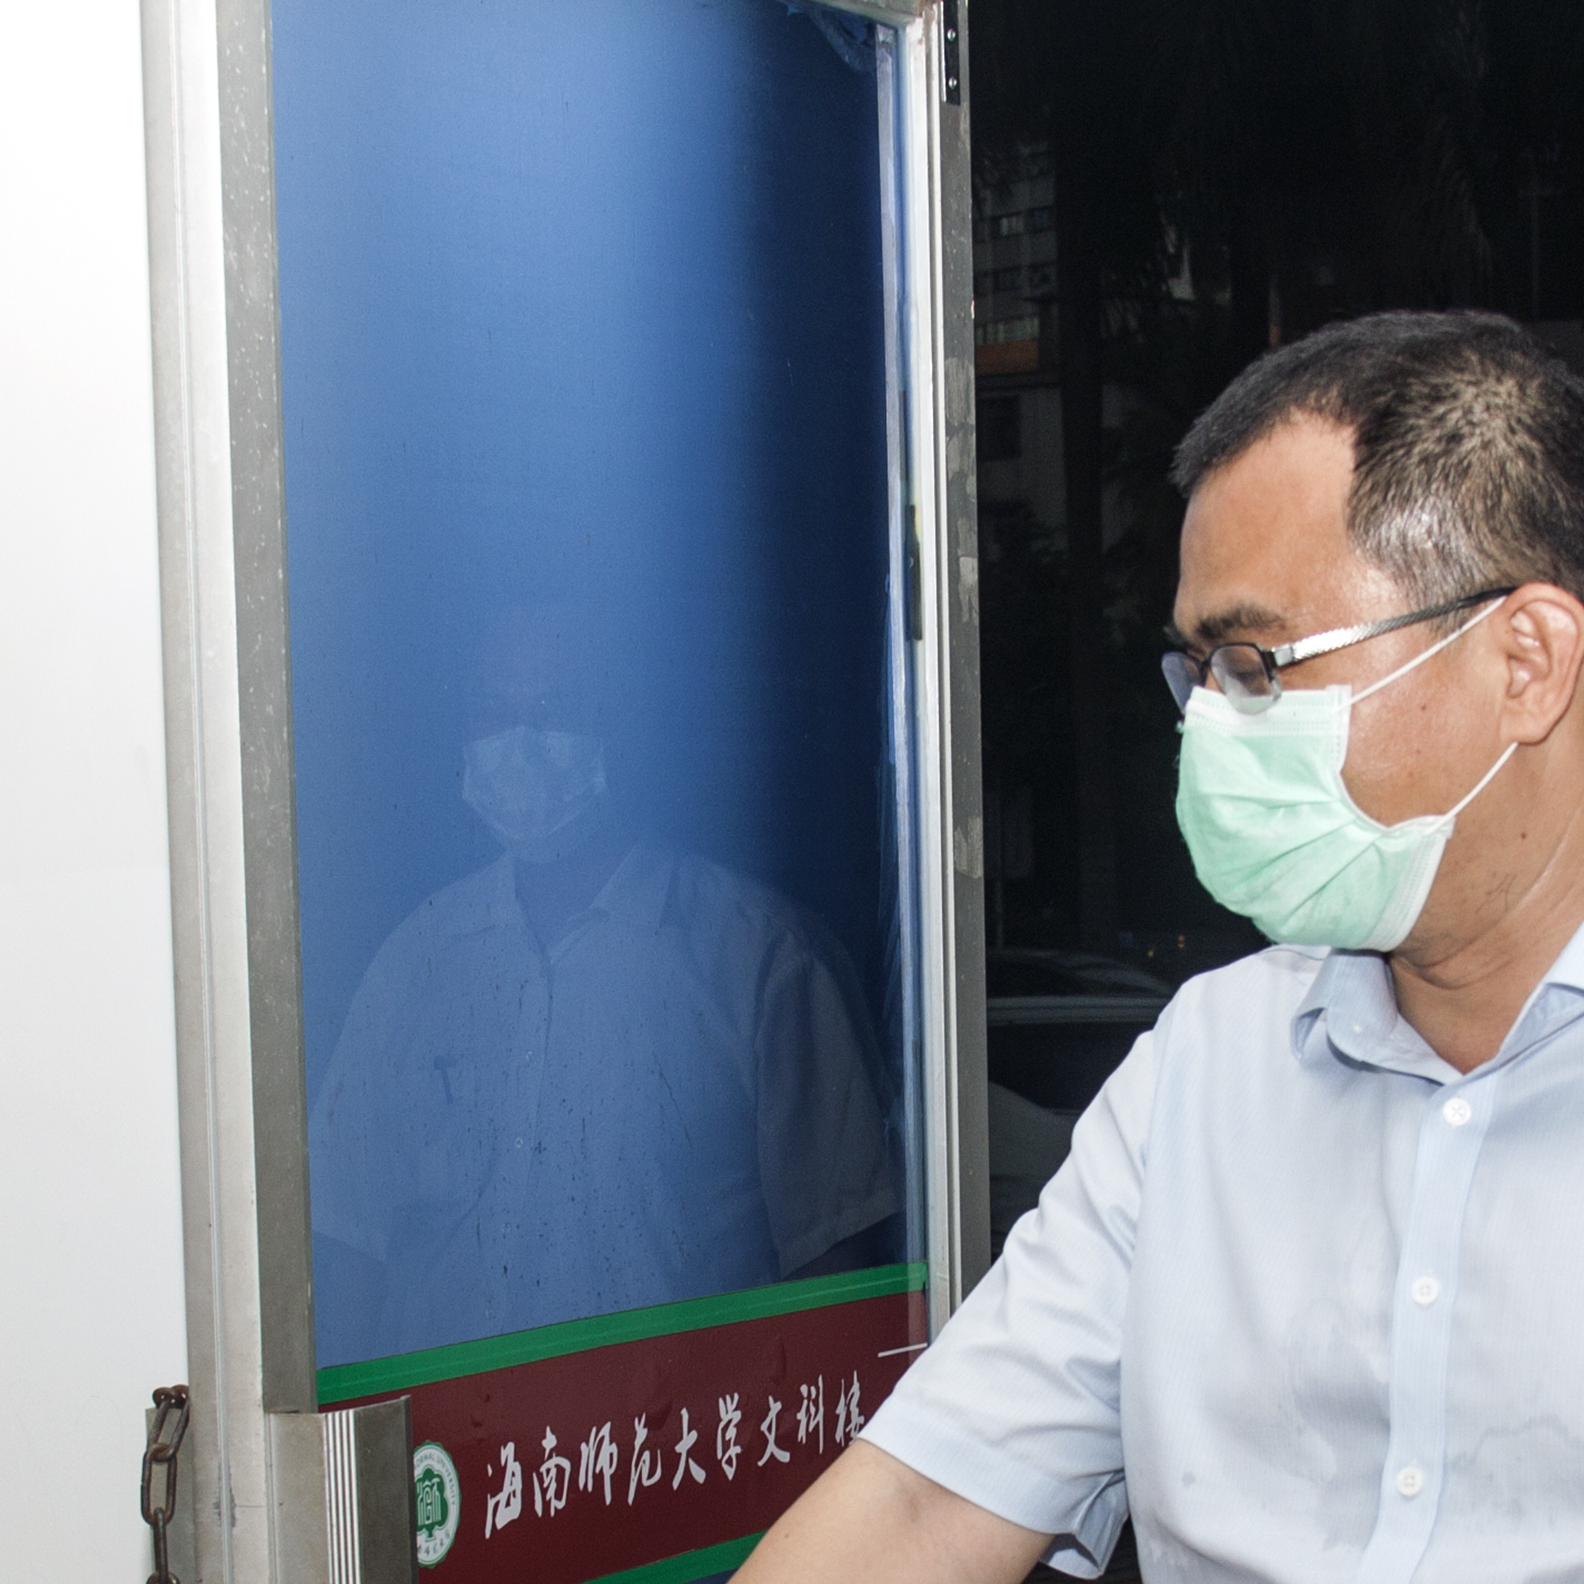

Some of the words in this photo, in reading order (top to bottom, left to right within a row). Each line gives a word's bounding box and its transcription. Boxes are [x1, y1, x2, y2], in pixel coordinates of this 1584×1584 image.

[484, 1369, 865, 1540] 海南师范大学文科楼
